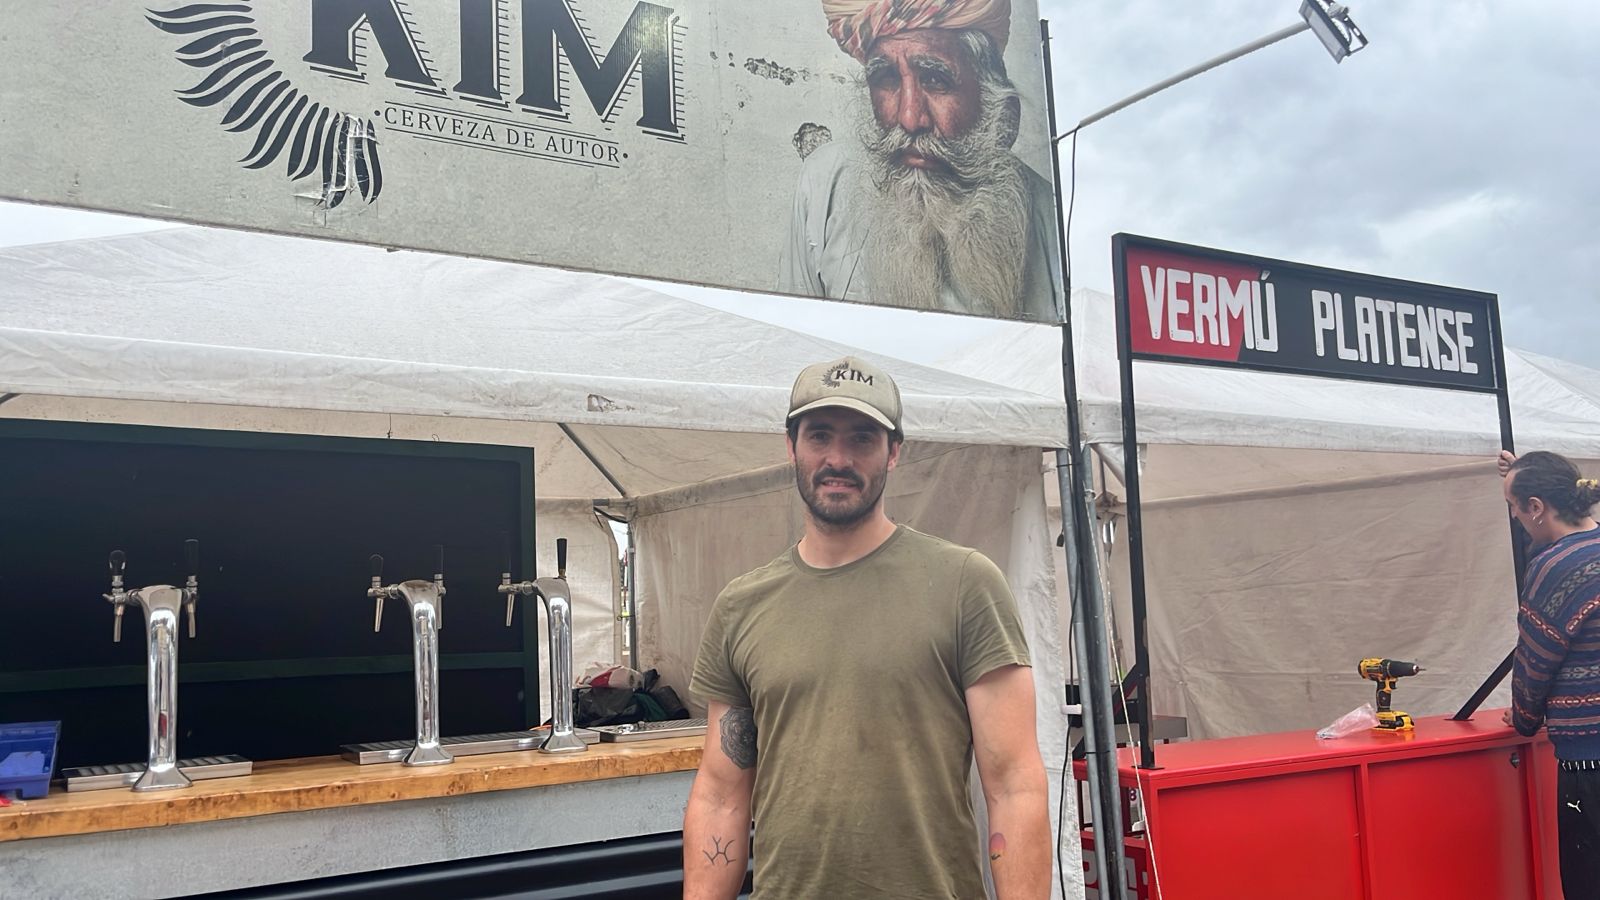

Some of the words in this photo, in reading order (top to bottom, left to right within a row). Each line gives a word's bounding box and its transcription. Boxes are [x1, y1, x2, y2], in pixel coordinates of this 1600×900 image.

[383, 106, 496, 142] CERVEZA
[506, 127, 536, 149] DE
[545, 134, 620, 163] AUTOR
[1140, 264, 1279, 353] VERMÚ
[1311, 289, 1480, 375] PLATENSE
[834, 368, 874, 386] KIM
